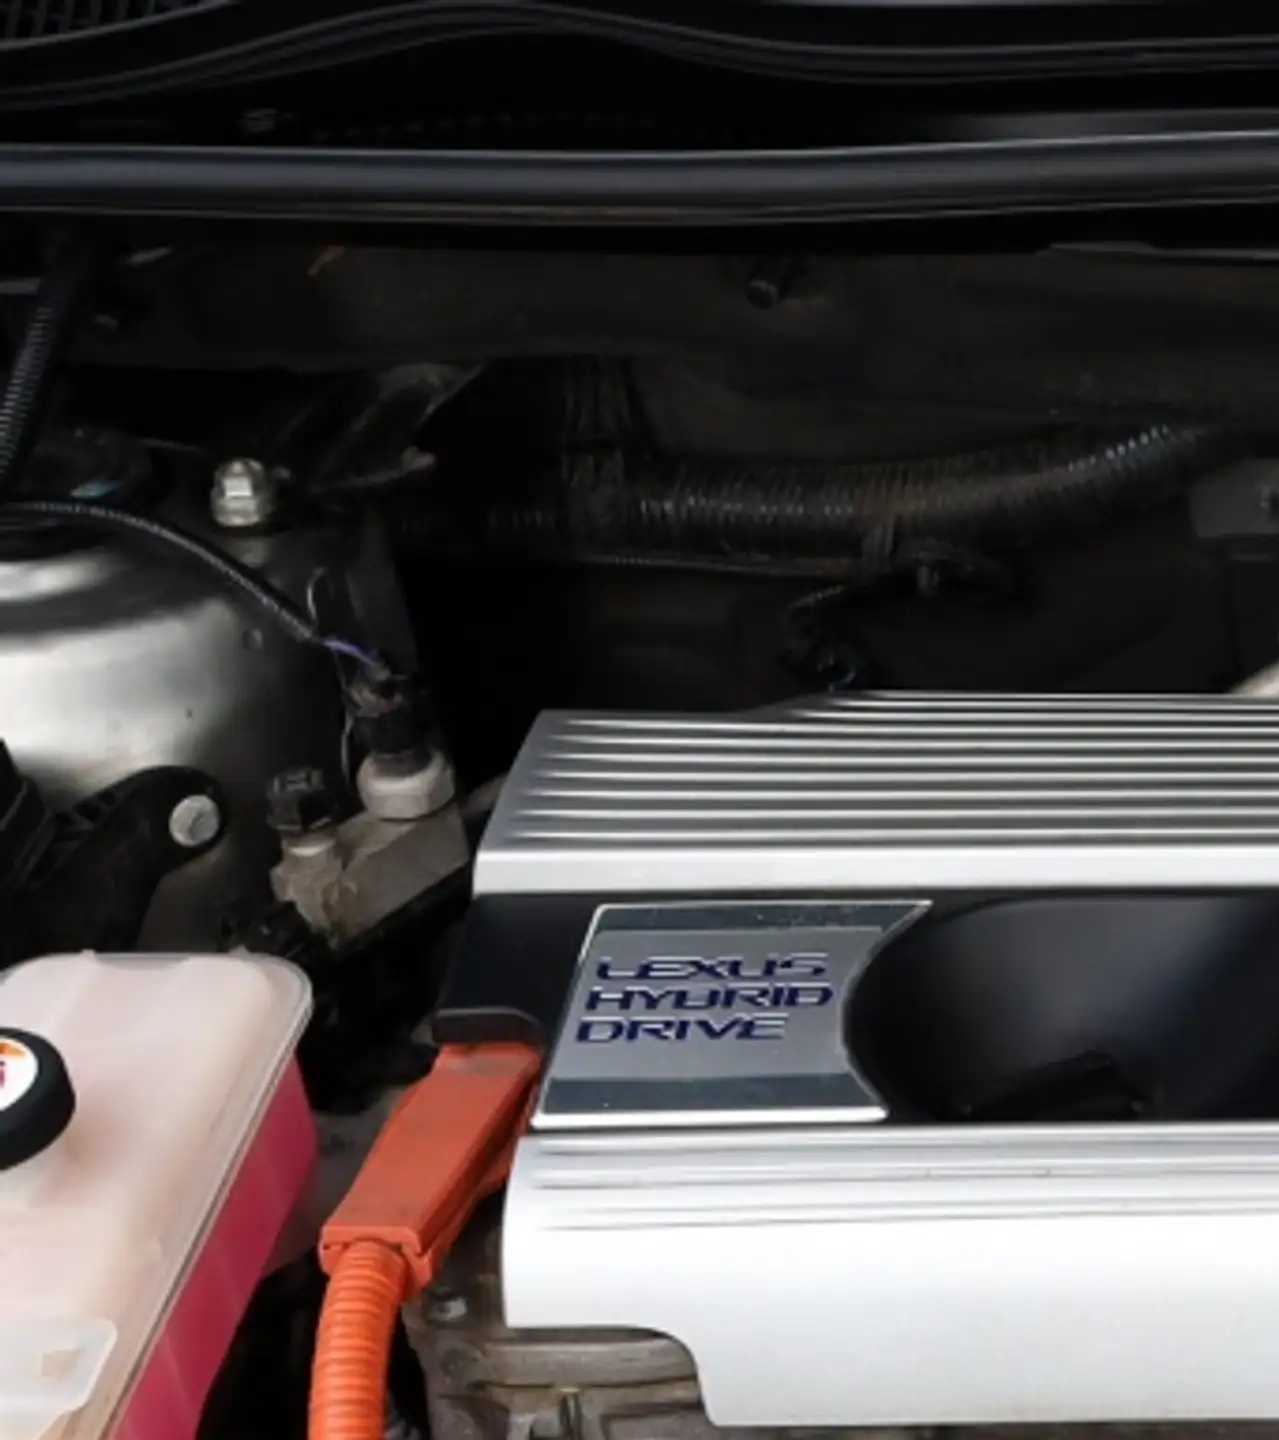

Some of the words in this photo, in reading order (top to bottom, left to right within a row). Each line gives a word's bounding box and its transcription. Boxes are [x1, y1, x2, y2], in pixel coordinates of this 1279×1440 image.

[597, 953, 829, 979] LEXUS
[585, 981, 834, 1011] HYBRID
[575, 1012, 789, 1043] DRIVE
